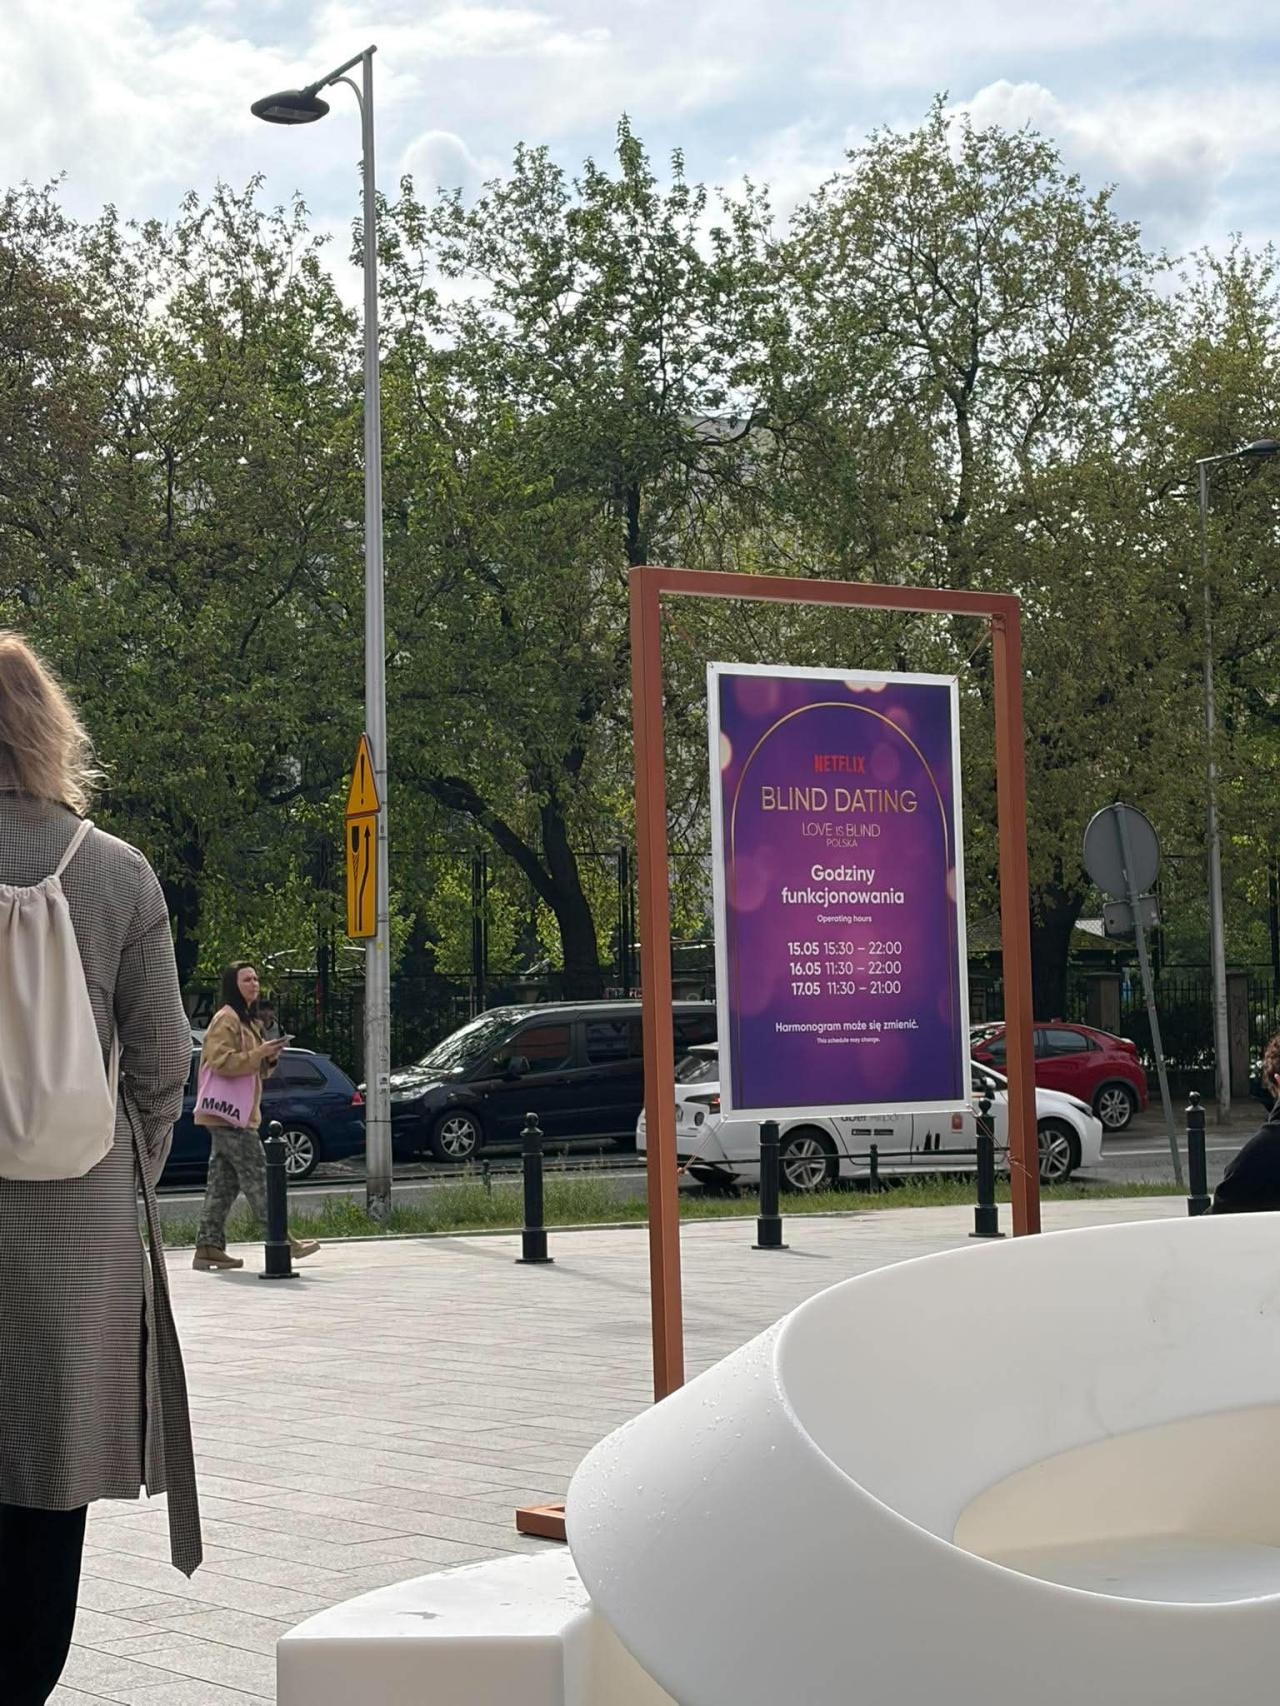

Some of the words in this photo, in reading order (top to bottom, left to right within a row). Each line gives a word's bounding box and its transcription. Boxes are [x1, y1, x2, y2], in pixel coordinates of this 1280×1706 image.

[814, 755, 864, 773] NETFLIX
[761, 786, 828, 812] BLIND
[834, 788, 918, 813] DATING
[802, 822, 833, 837] LOVE
[846, 823, 881, 838] BLIND
[826, 838, 858, 848] POLSKA
[811, 864, 876, 885] Godziny
[781, 887, 905, 908] funkcjonowania
[816, 914, 852, 924] Operating
[853, 914, 872, 923] hours
[787, 941, 820, 956] 15.05
[823, 941, 854, 955] 15:30
[868, 941, 902, 955] 22:00
[789, 962, 822, 976] 16.05
[825, 961, 854, 975] 11:30
[868, 960, 902, 975] 22:00
[791, 982, 821, 996] 17.05
[827, 981, 855, 995] 11:30
[870, 980, 901, 995] 21:00
[775, 1022, 841, 1034] Harmonogram
[843, 1020, 867, 1031] może
[869, 1019, 881, 1032] się
[883, 1018, 919, 1030] zmienić.
[201, 1097, 241, 1120] MoMA
